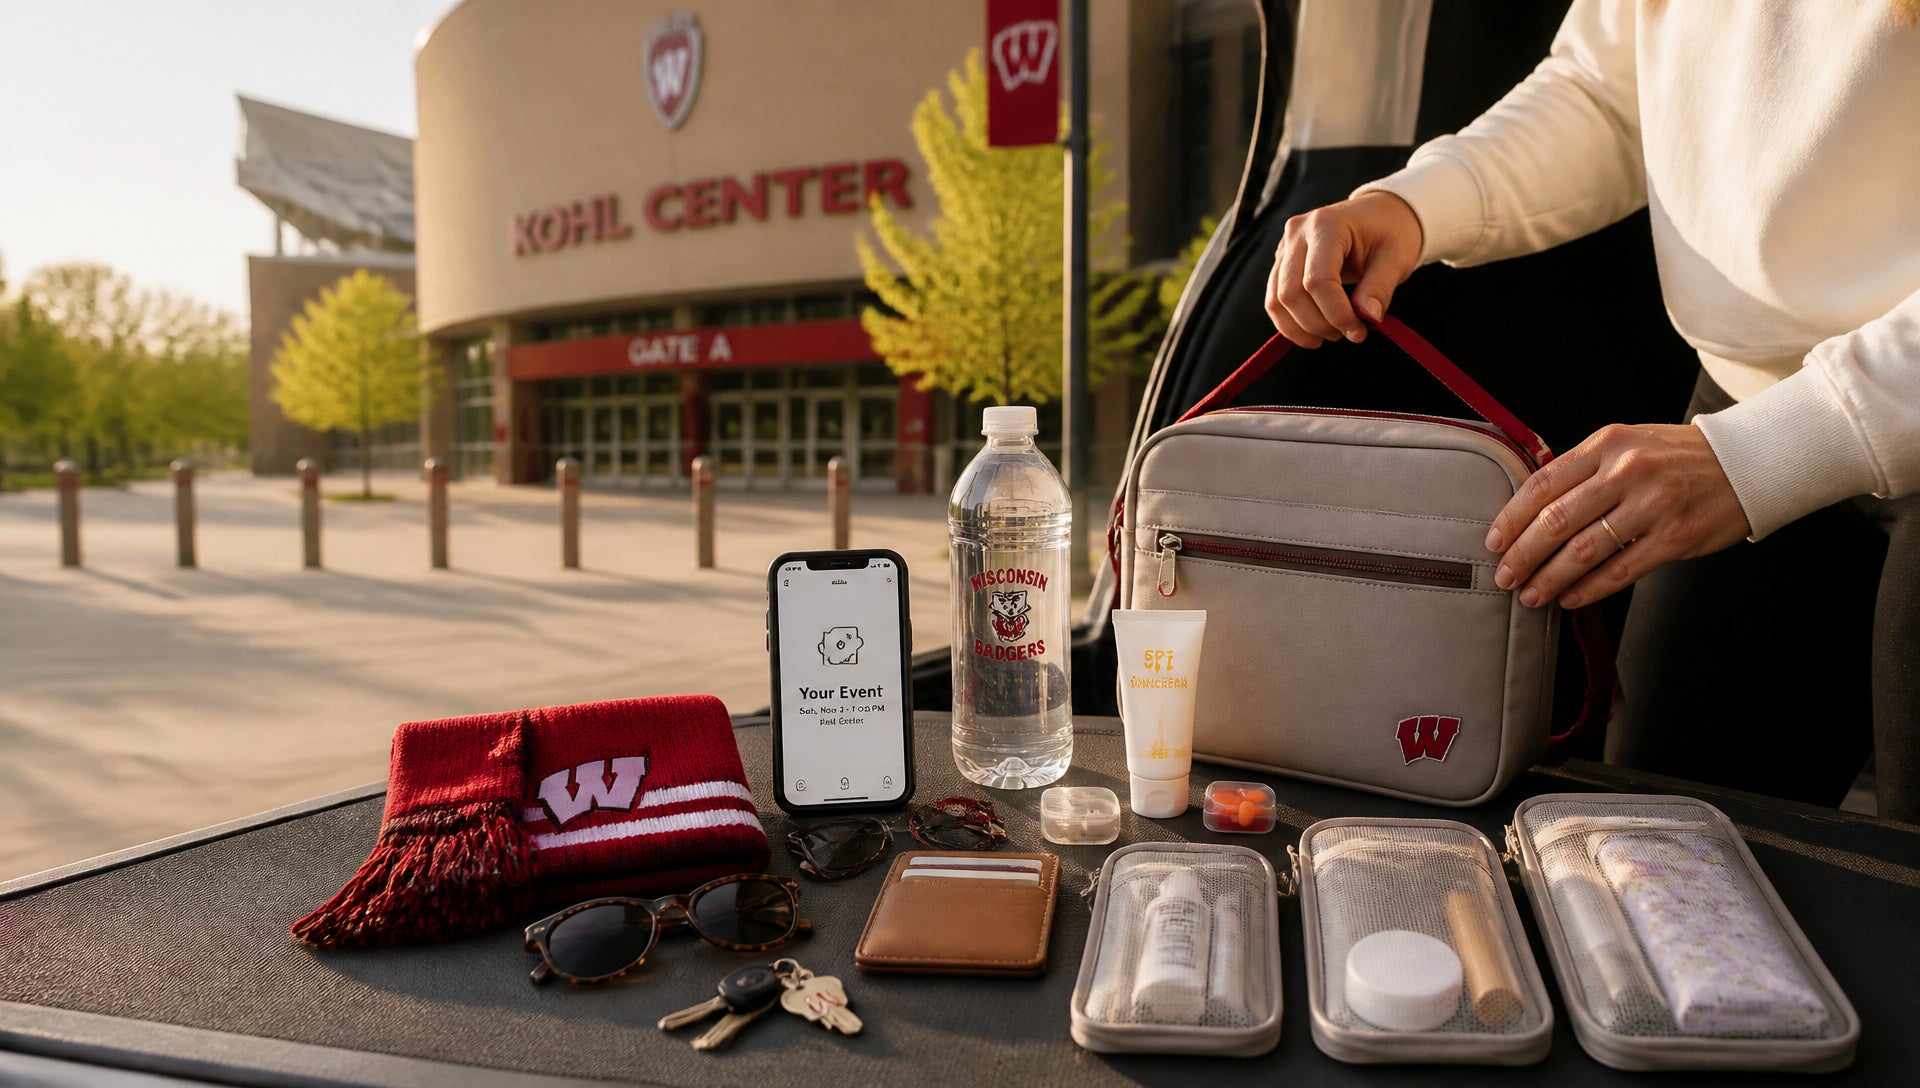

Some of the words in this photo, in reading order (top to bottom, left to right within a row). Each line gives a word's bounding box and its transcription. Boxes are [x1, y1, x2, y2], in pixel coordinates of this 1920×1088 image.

[653, 48, 687, 103] W
[992, 20, 1057, 92] W
[511, 196, 630, 254] KOHL
[645, 160, 912, 231] CENTER
[628, 334, 700, 366] GATE
[708, 332, 733, 362] A
[970, 568, 1048, 592] WISCONSIN
[974, 639, 1046, 662] BADGERS
[799, 686, 835, 700] Your
[839, 684, 884, 699] Event
[1395, 714, 1461, 766] W
[537, 755, 646, 828] W
